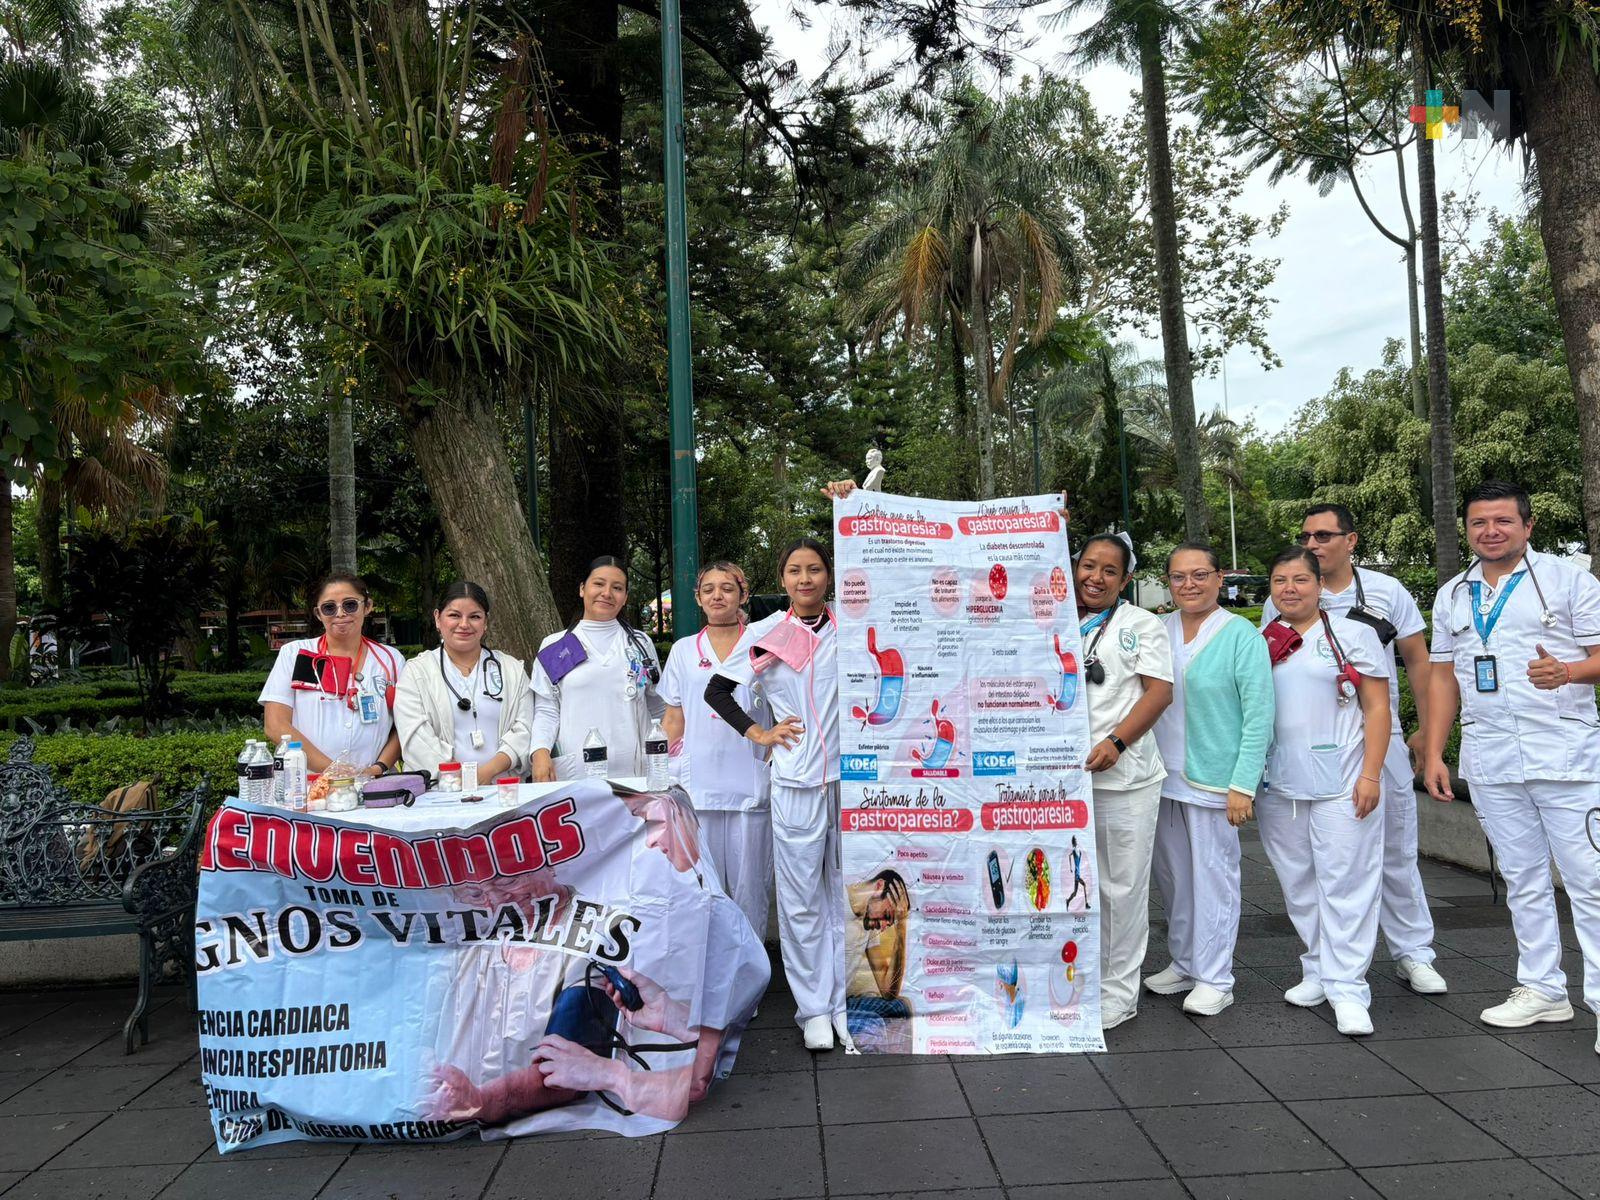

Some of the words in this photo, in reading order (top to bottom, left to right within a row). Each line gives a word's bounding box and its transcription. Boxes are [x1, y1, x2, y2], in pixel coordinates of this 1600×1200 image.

[851, 518, 941, 537] gastroparesia?
[968, 512, 1051, 535] gastroparesia?
[980, 543, 986, 551] La
[986, 542, 1008, 550] diabetes
[1009, 541, 1045, 550] descontrolada
[945, 580, 958, 588] capaz
[895, 601, 911, 609] Impide
[985, 700, 1007, 708] funcionan
[916, 788, 929, 809] de
[933, 786, 946, 809] la
[850, 810, 959, 832] gastroparesia?
[992, 803, 1074, 830] gastroparesia:
[910, 851, 928, 859] apetito
[946, 873, 964, 881] vómito
[304, 886, 365, 906] TOMA
[372, 890, 399, 906] DE
[925, 906, 947, 914] Saciedad
[371, 896, 642, 963] VITALES
[199, 1010, 244, 1037] ENCIA
[248, 1003, 350, 1037] CARDIACA
[248, 1041, 387, 1078] RESPIRATORIA
[266, 1108, 292, 1131] DE
